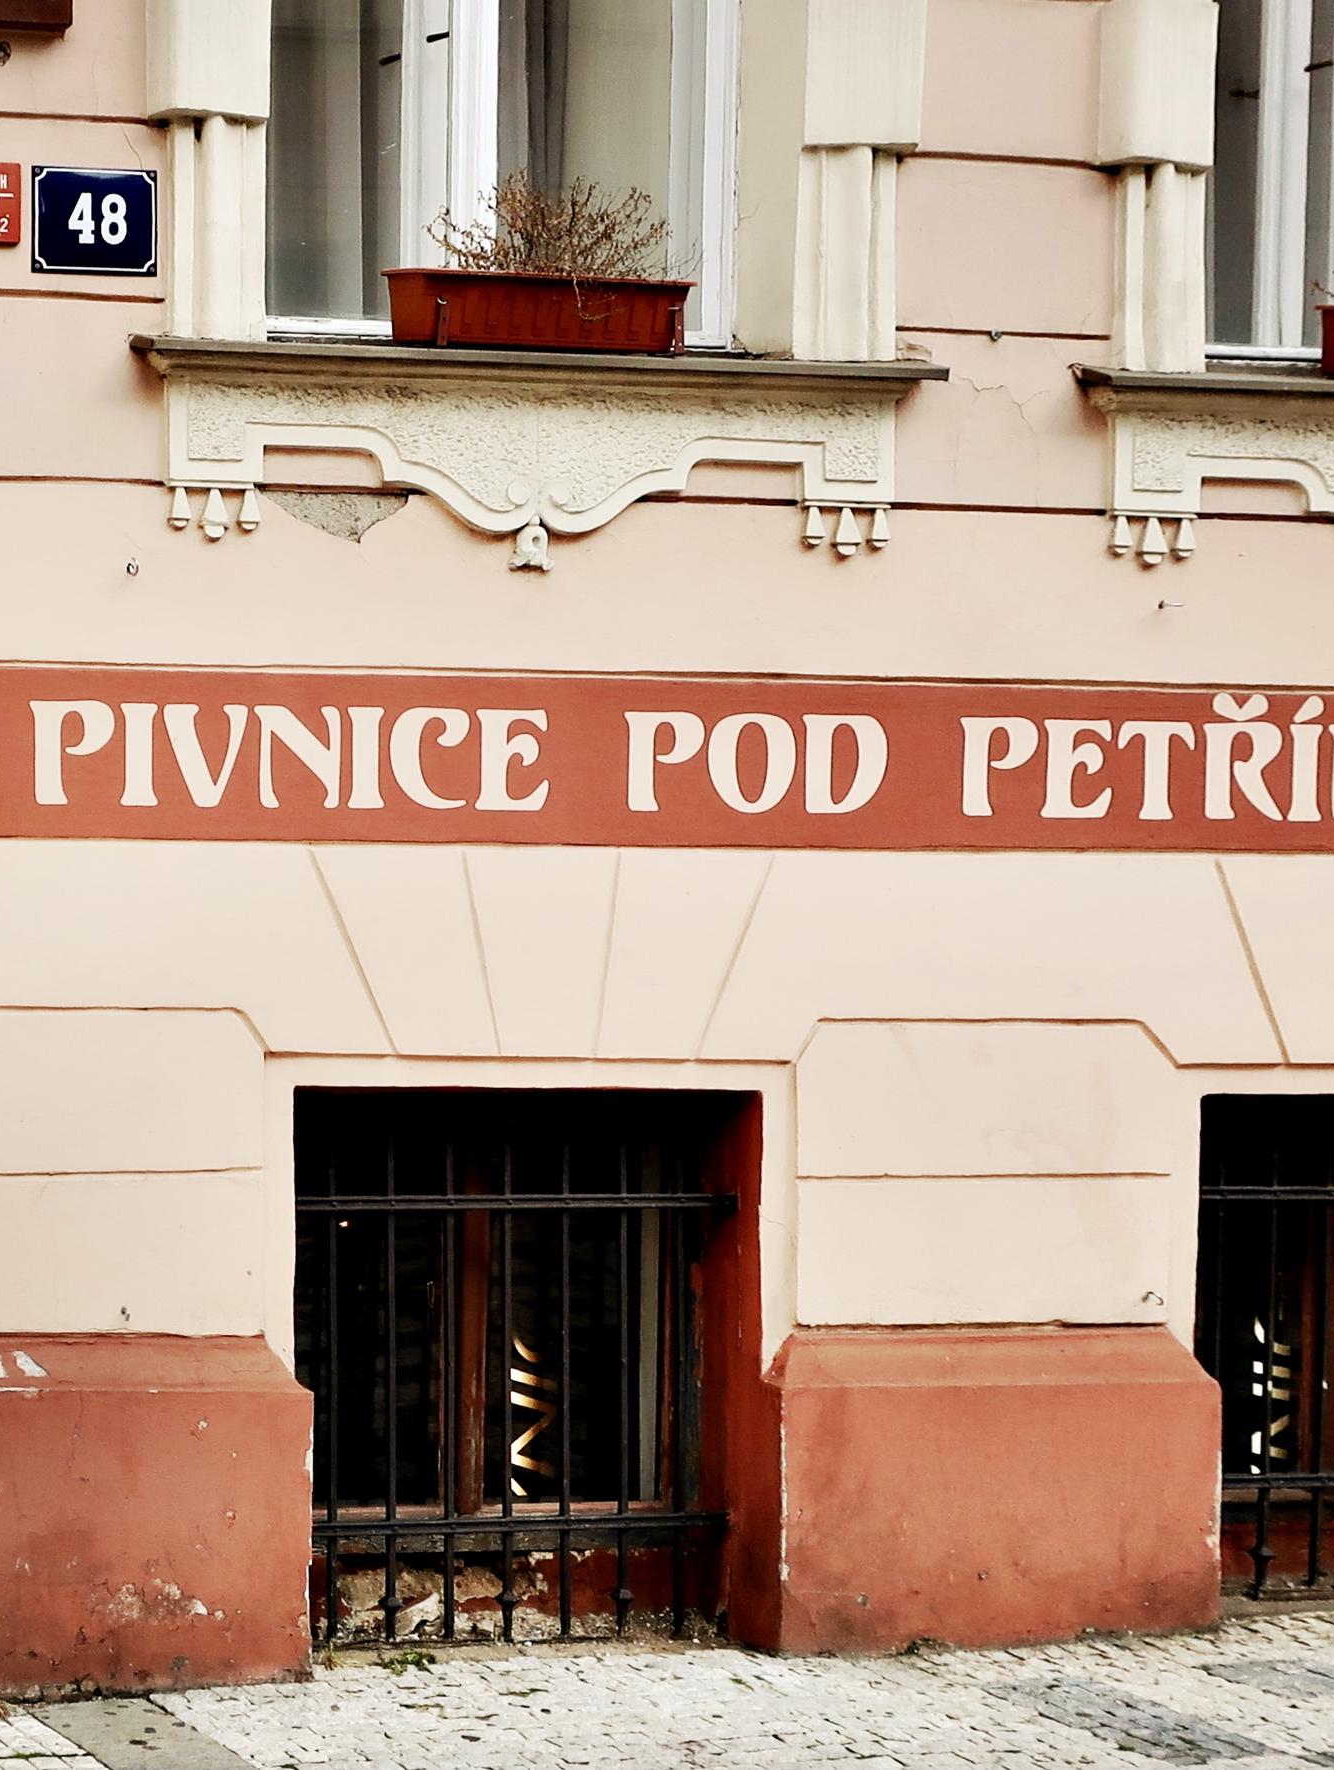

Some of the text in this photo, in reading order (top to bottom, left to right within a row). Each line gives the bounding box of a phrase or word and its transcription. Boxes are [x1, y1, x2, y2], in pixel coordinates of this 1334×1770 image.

[0, 174, 8, 189] H
[68, 192, 128, 246] 48
[28, 698, 550, 812] PIVNICE
[624, 711, 888, 814] POD
